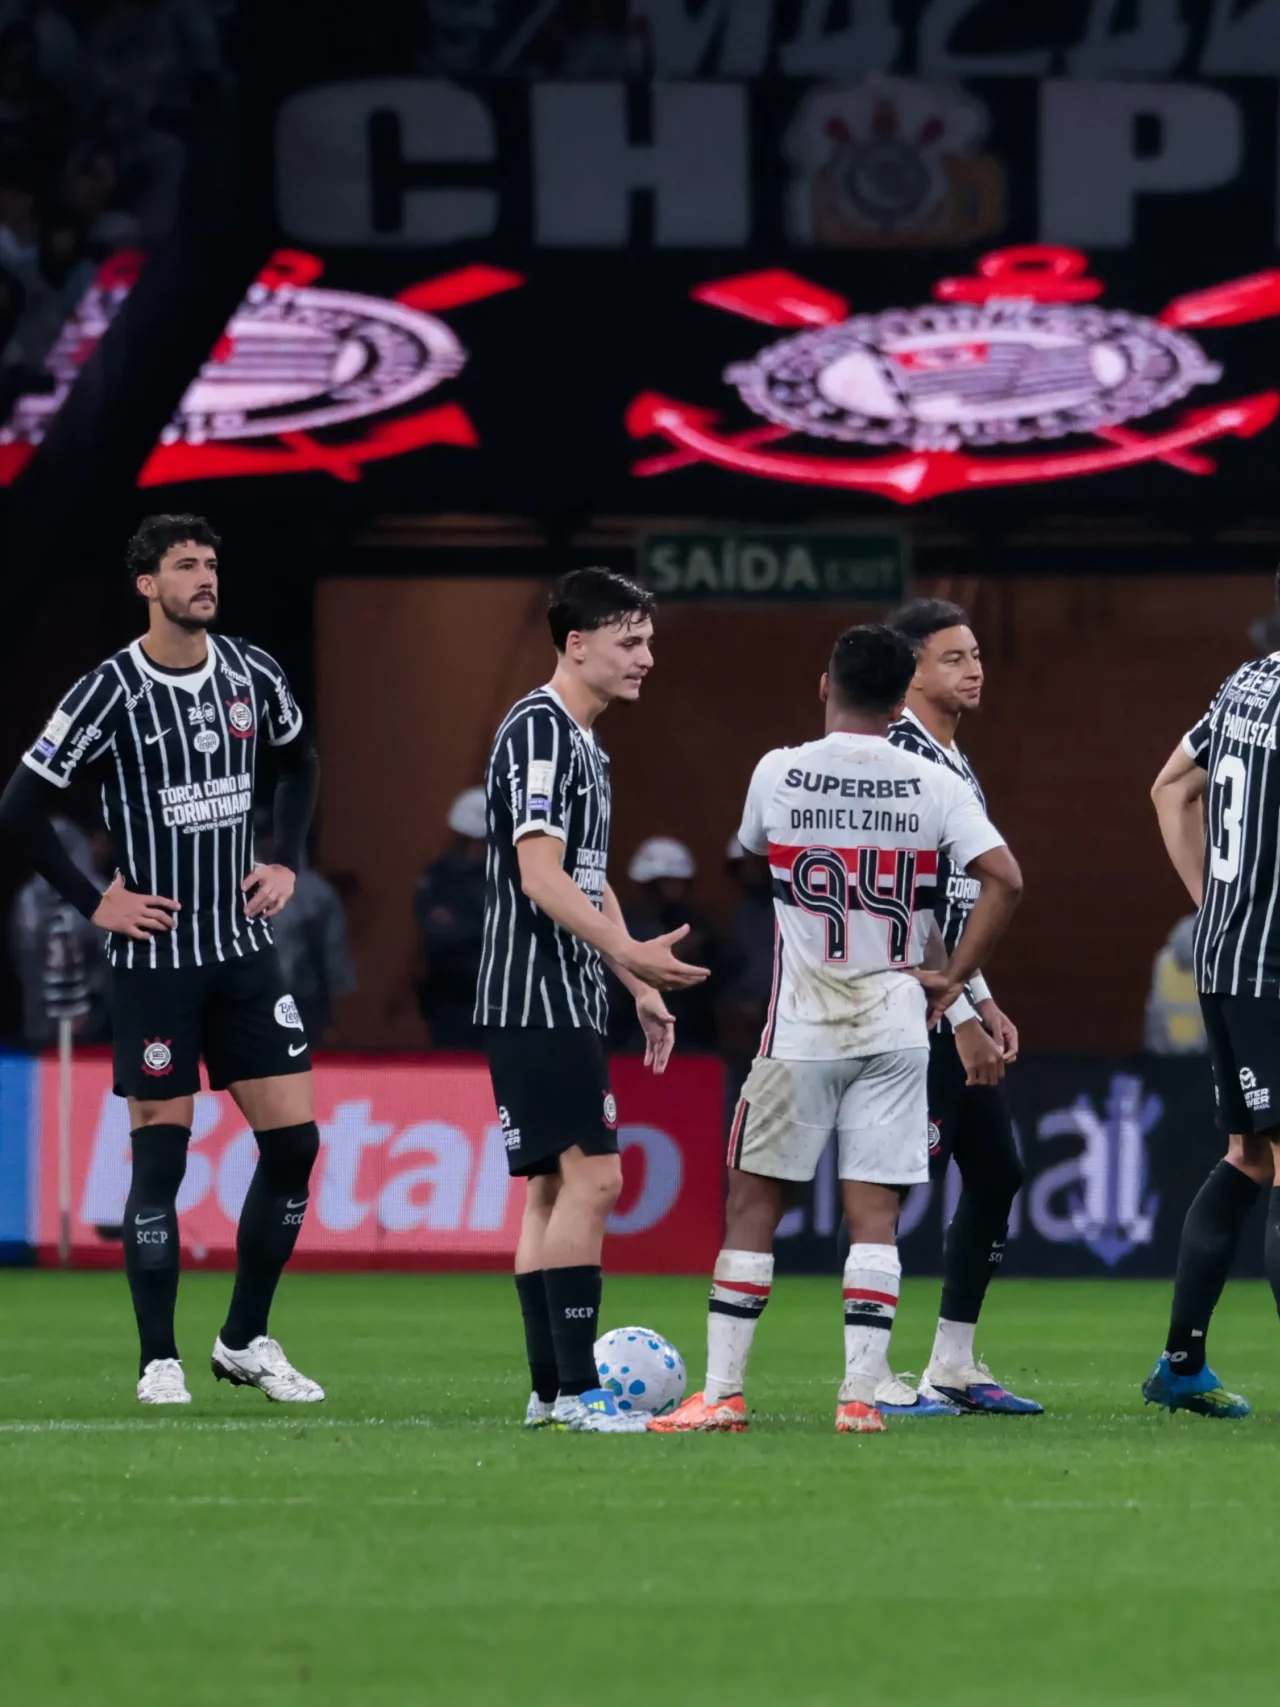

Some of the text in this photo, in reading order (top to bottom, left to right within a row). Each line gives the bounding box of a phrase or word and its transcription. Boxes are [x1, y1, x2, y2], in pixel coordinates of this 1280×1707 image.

[651, 540, 819, 591] SAÍDA
[1244, 695, 1267, 709] AUTO
[1223, 712, 1277, 751] PAULISTA
[158, 773, 250, 806] TORÇA COMO UM
[785, 768, 921, 799] SUPERBET
[162, 791, 251, 828] CORINTHIANO
[791, 808, 920, 833] DANIELZINHO
[1212, 754, 1246, 884] 3
[791, 845, 918, 966] 94
[137, 1230, 168, 1245] SCCP
[565, 1307, 594, 1319] SCCP
